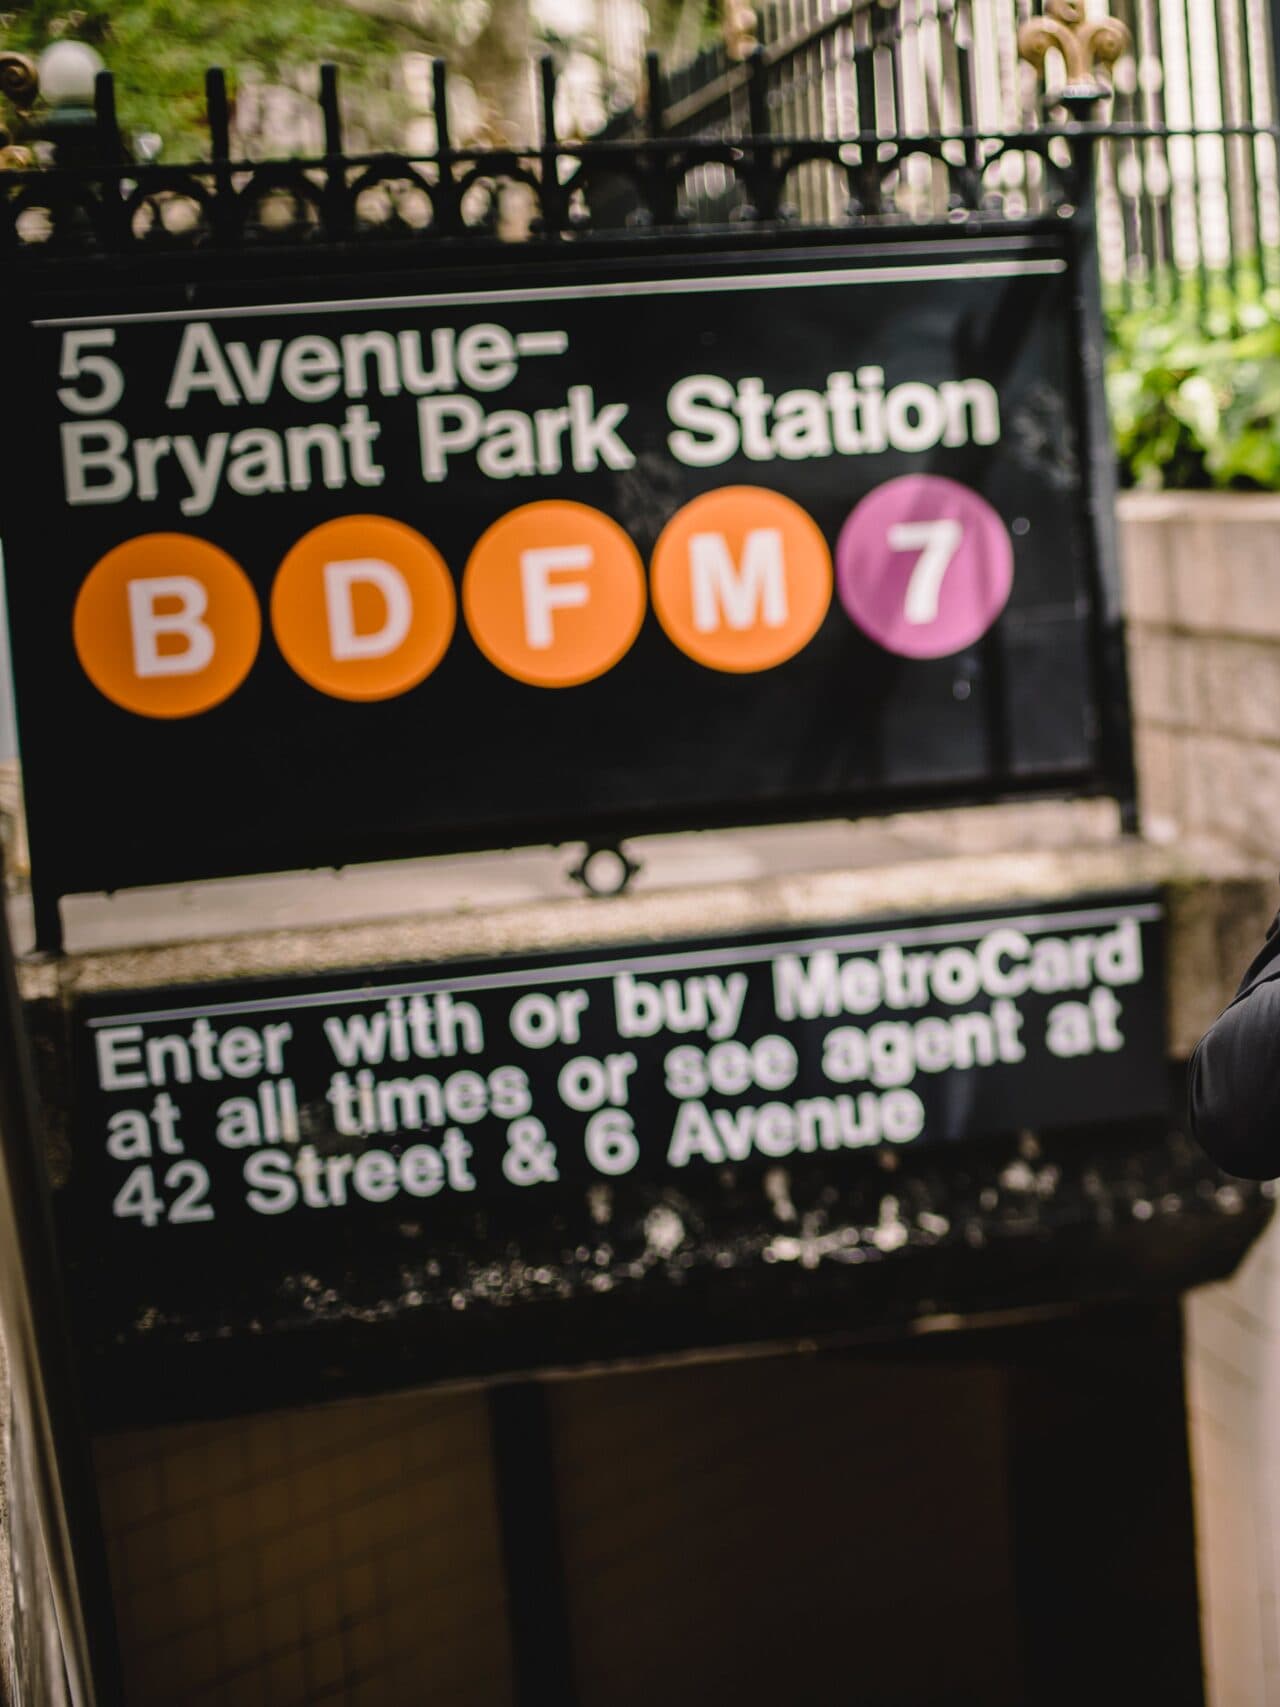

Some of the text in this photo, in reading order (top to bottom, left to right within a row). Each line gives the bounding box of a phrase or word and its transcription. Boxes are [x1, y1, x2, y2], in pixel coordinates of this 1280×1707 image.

[58, 329, 124, 413] 5
[61, 366, 1000, 516] Bryant Park Station
[127, 518, 963, 679] B D F M 7
[96, 918, 1144, 1091] Enter with or buy MetroCard
[104, 987, 1123, 1162] at all times or see agent at
[112, 1085, 924, 1227] 42 Street & 6 Avenue
